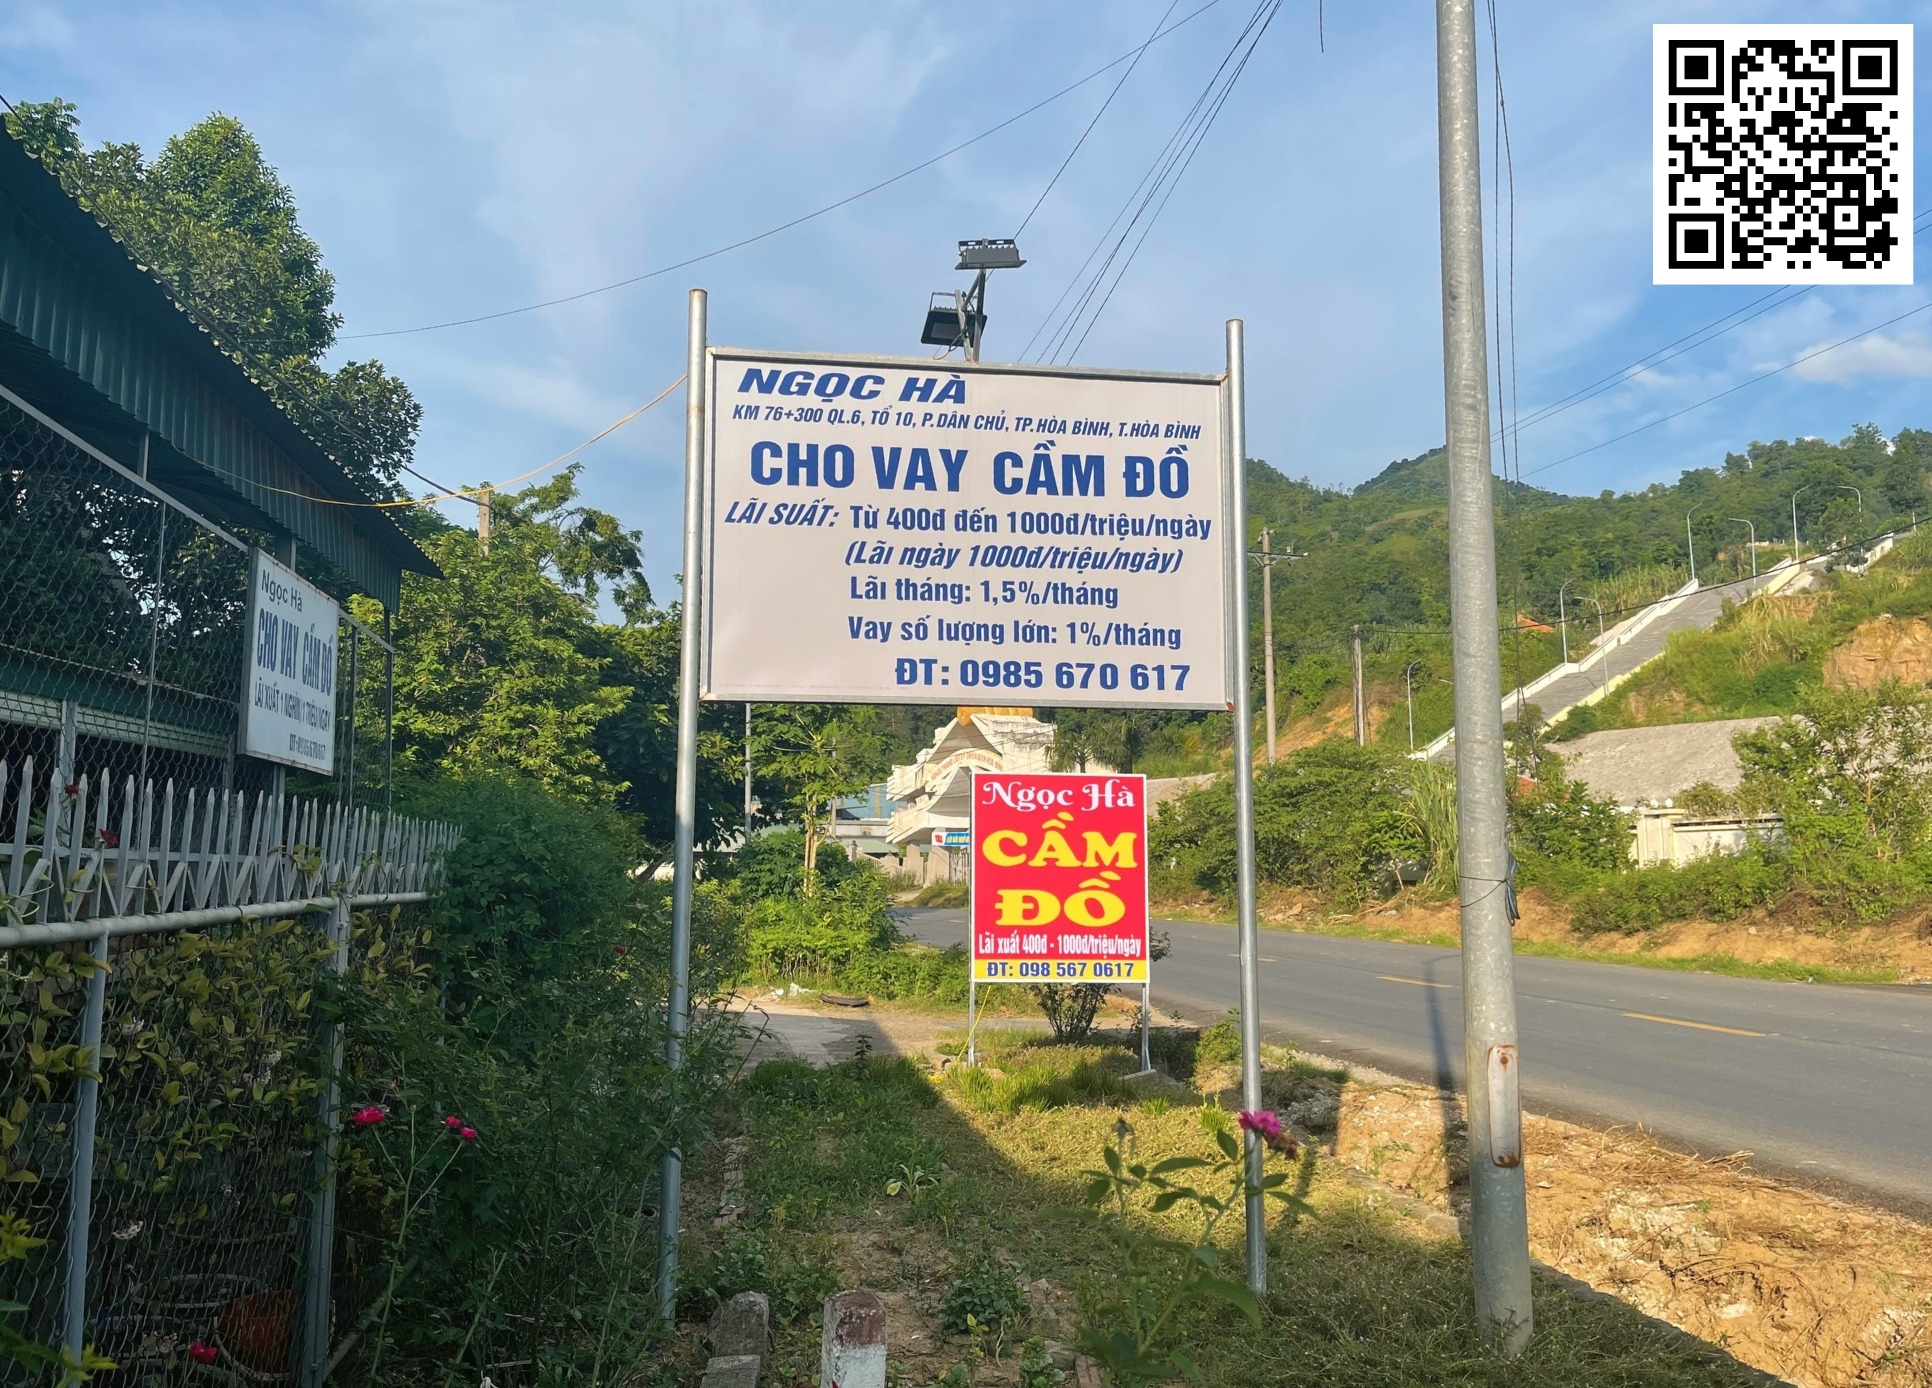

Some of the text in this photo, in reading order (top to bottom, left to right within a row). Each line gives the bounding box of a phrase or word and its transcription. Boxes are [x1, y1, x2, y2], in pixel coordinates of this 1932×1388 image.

[738, 368, 967, 405] NGỌC HÀ
[733, 405, 1201, 439] KM 76+300 QL.6, TỔ 10, P.DÂN CHỦ, TP.HÒA BÌNH, T.HÒA BÌNH
[751, 440, 1189, 498] CHO VAY CẦM ĐỒ
[724, 498, 1211, 541] LÃI SUẤT: Từ 400đ đến 1000đ/triệu/ngày
[845, 540, 1183, 574] (Lãi ngày 1000đ/triệu/ngày)
[261, 569, 303, 612] Ngọc Hà
[851, 575, 1118, 609] Lãi tháng: 1,5%/tháng
[848, 615, 1180, 650] Vay số lượng lớn: 1%/tháng
[256, 608, 333, 697] CHO VAY CẦM ĐỒ
[895, 658, 1190, 690] ĐT: 0985 670 617
[983, 779, 1134, 811] Ngọc Hà
[983, 812, 1137, 868] CẦM
[995, 871, 1125, 926] ĐỒ
[979, 932, 994, 954] Lãi
[998, 930, 1020, 954] xuất
[1022, 934, 1047, 954] 400đ
[1057, 934, 1141, 958] 1000đ/triệu/ngày
[987, 962, 1134, 977] ĐT: 098 567 0617
